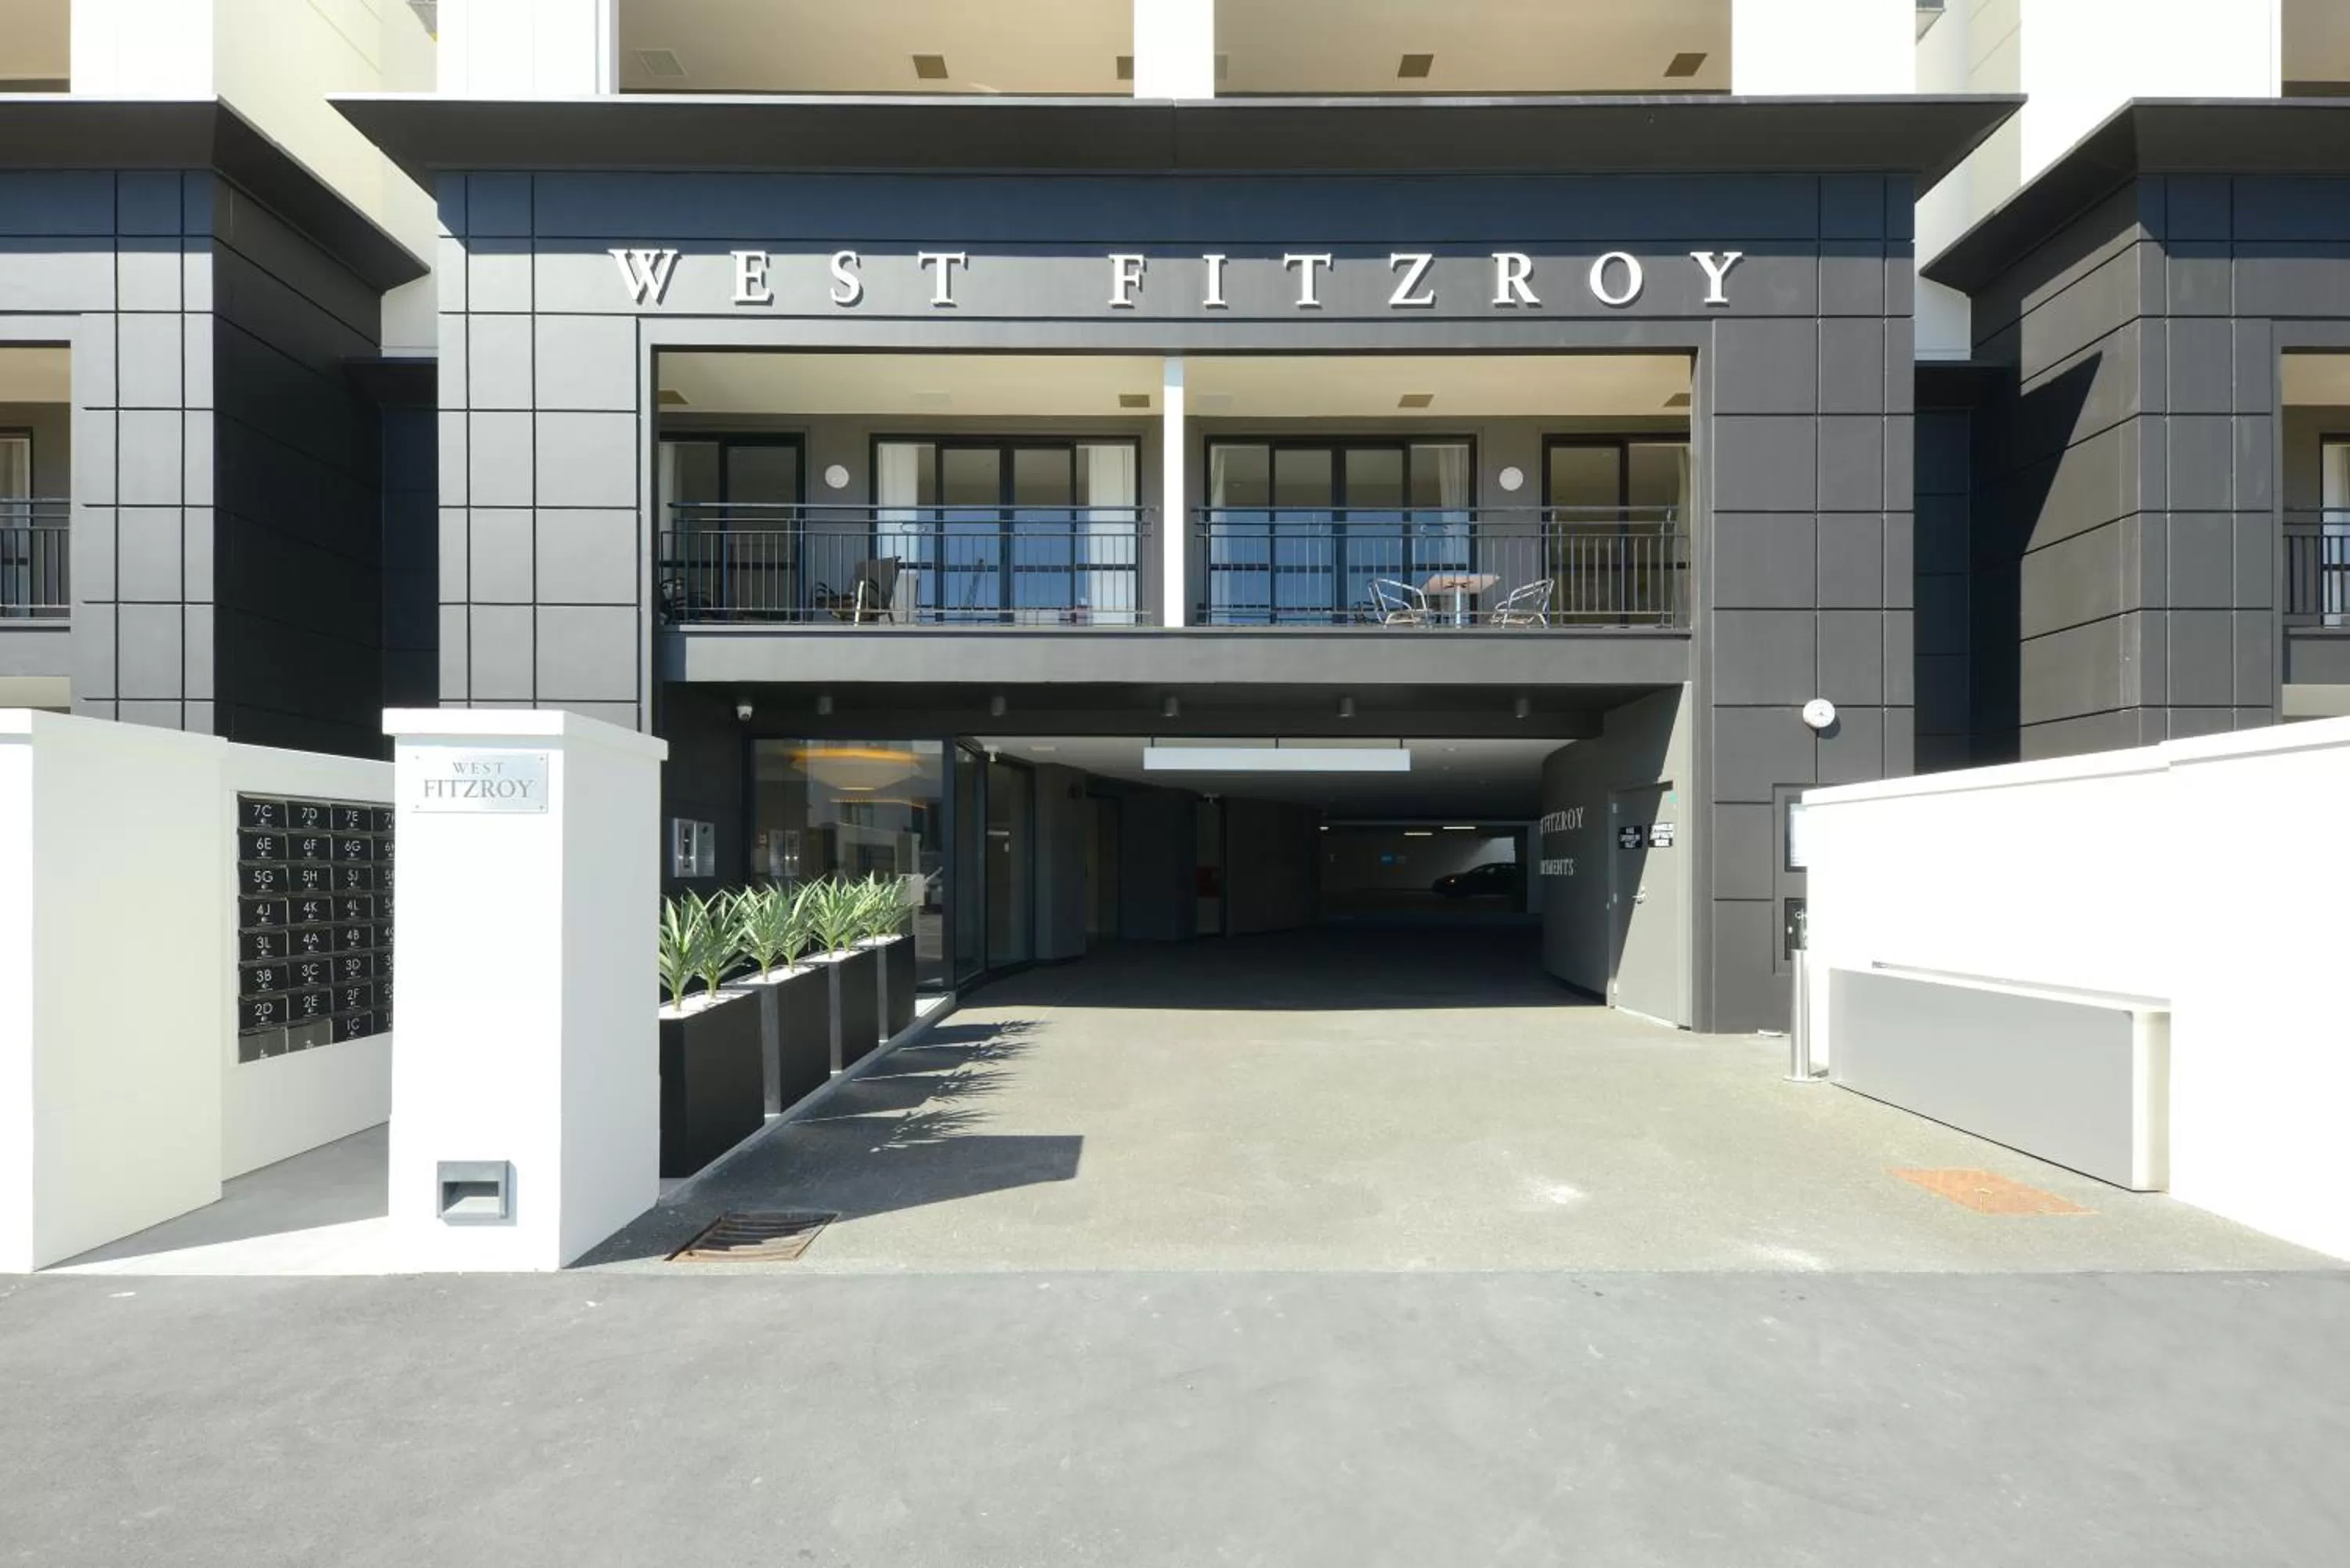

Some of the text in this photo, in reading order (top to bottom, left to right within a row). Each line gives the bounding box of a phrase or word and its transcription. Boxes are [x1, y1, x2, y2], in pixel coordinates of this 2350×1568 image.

[608, 248, 1743, 305] WEST FITZROY
[452, 762, 504, 775] WEST
[424, 779, 534, 799] FITZROY
[253, 804, 273, 817] 7C
[302, 807, 317, 819] 7D
[345, 810, 358, 822] 7E
[256, 836, 272, 850] 6E
[303, 839, 316, 850] 6F
[345, 840, 360, 851] 6G
[253, 869, 273, 883] 5G
[302, 870, 317, 882] 5H
[256, 903, 270, 916] 4J
[303, 901, 318, 912] 4K
[256, 936, 271, 948] 3L
[303, 933, 319, 944] 4A
[256, 969, 272, 983] 3B
[302, 963, 320, 977] 3C
[347, 988, 360, 1000] 2F
[303, 995, 318, 1008] 2E
